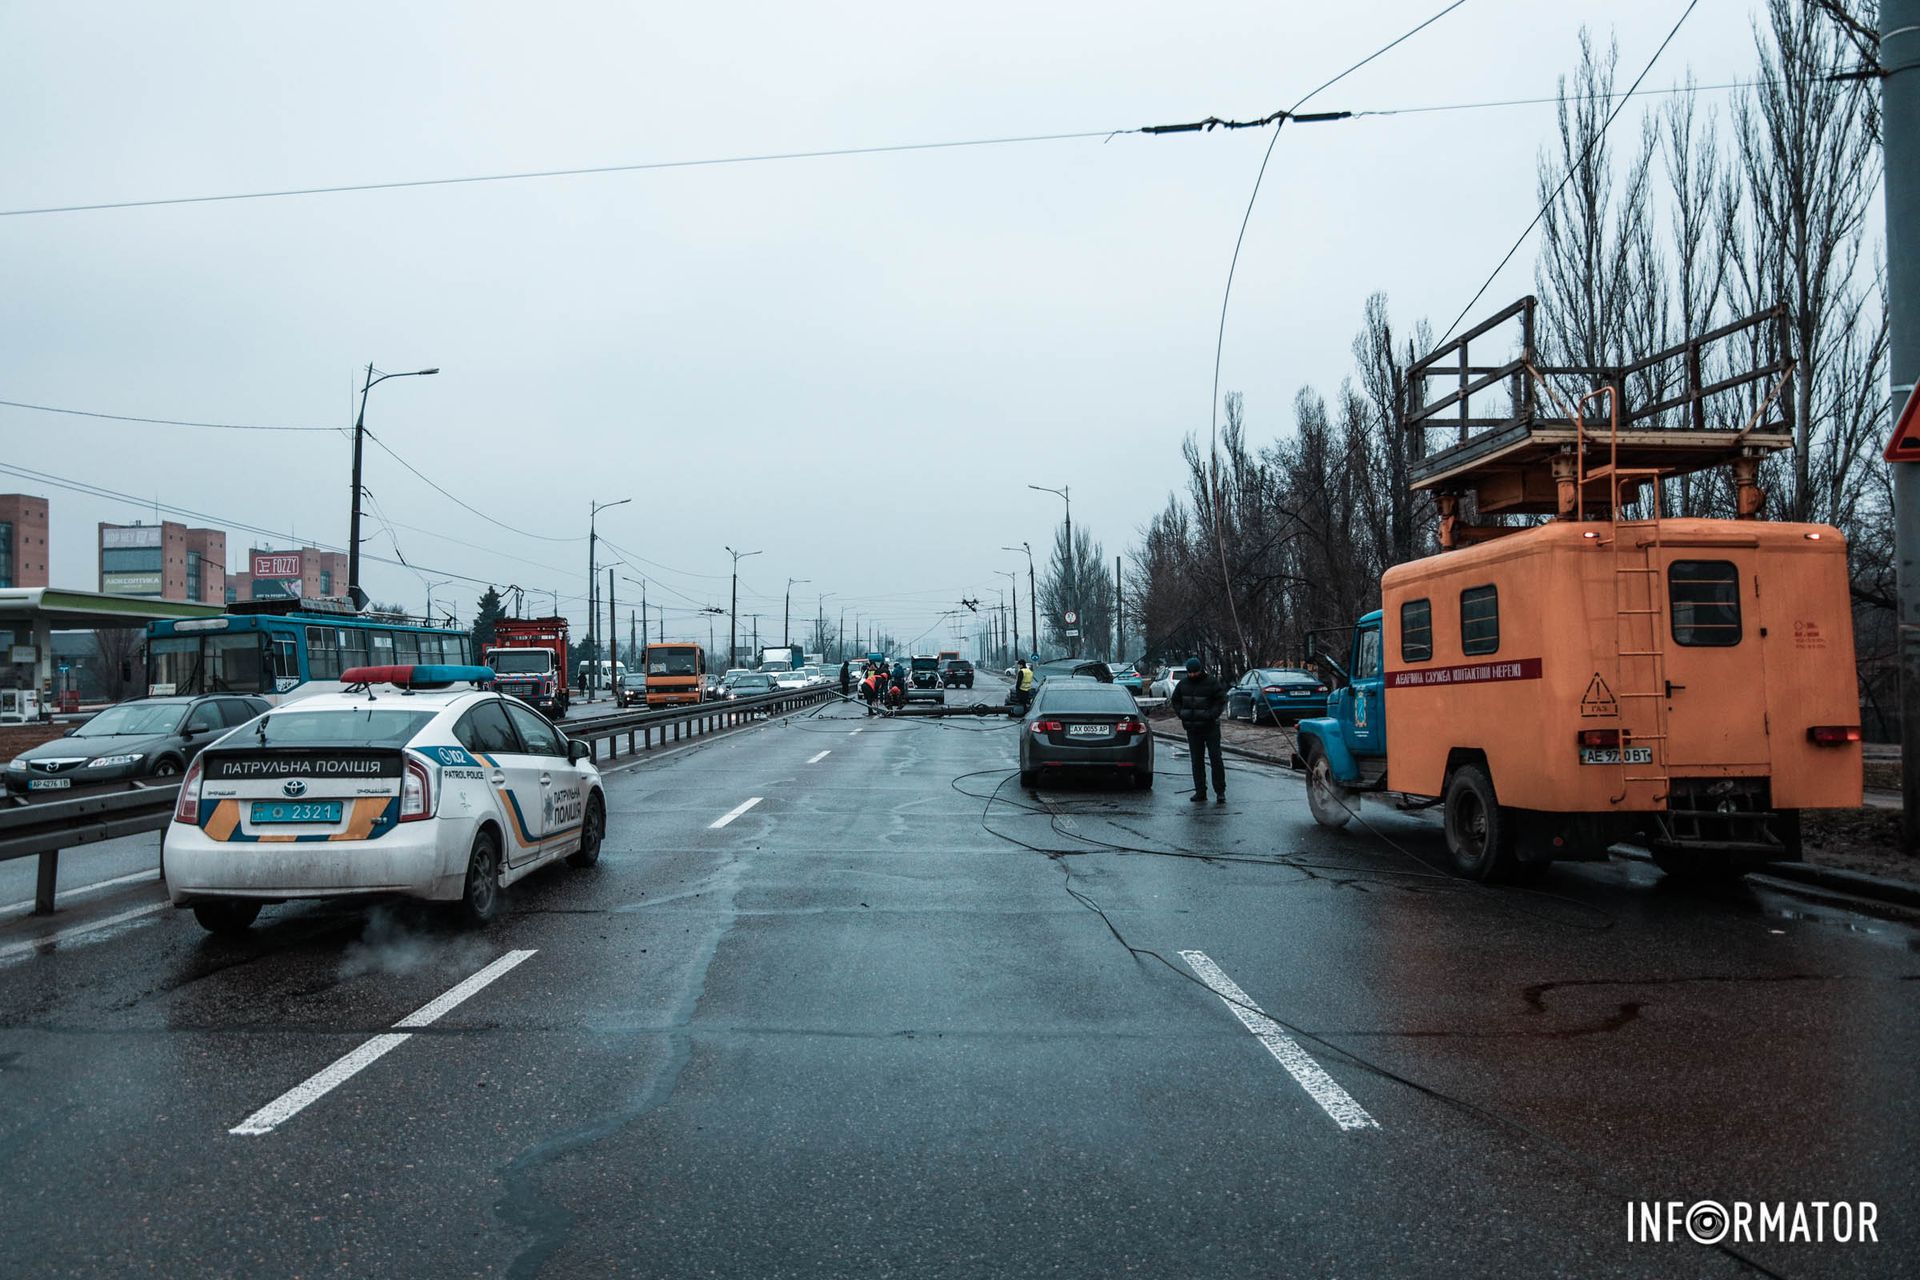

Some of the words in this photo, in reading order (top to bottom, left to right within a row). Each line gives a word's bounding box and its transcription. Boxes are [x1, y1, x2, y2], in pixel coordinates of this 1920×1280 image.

[272, 558, 297, 574] FOZZY
[1425, 669, 1451, 684] СЛУЖБА
[1492, 663, 1521, 678] МЕРЕЖІ
[448, 749, 467, 763] 102
[1587, 749, 1603, 762] AE
[1604, 749, 1631, 762] 970
[1632, 749, 1649, 762] BT
[222, 760, 312, 775] ПАТРУЛЬНА
[315, 760, 381, 773] ПОЛІЦІЯ
[444, 770, 466, 779] PATROL
[466, 770, 485, 780] POLICE
[553, 786, 581, 805] ПАТРУЛЬНА
[291, 805, 332, 819] 2321
[554, 802, 582, 826] ПОЛІЦІЯ
